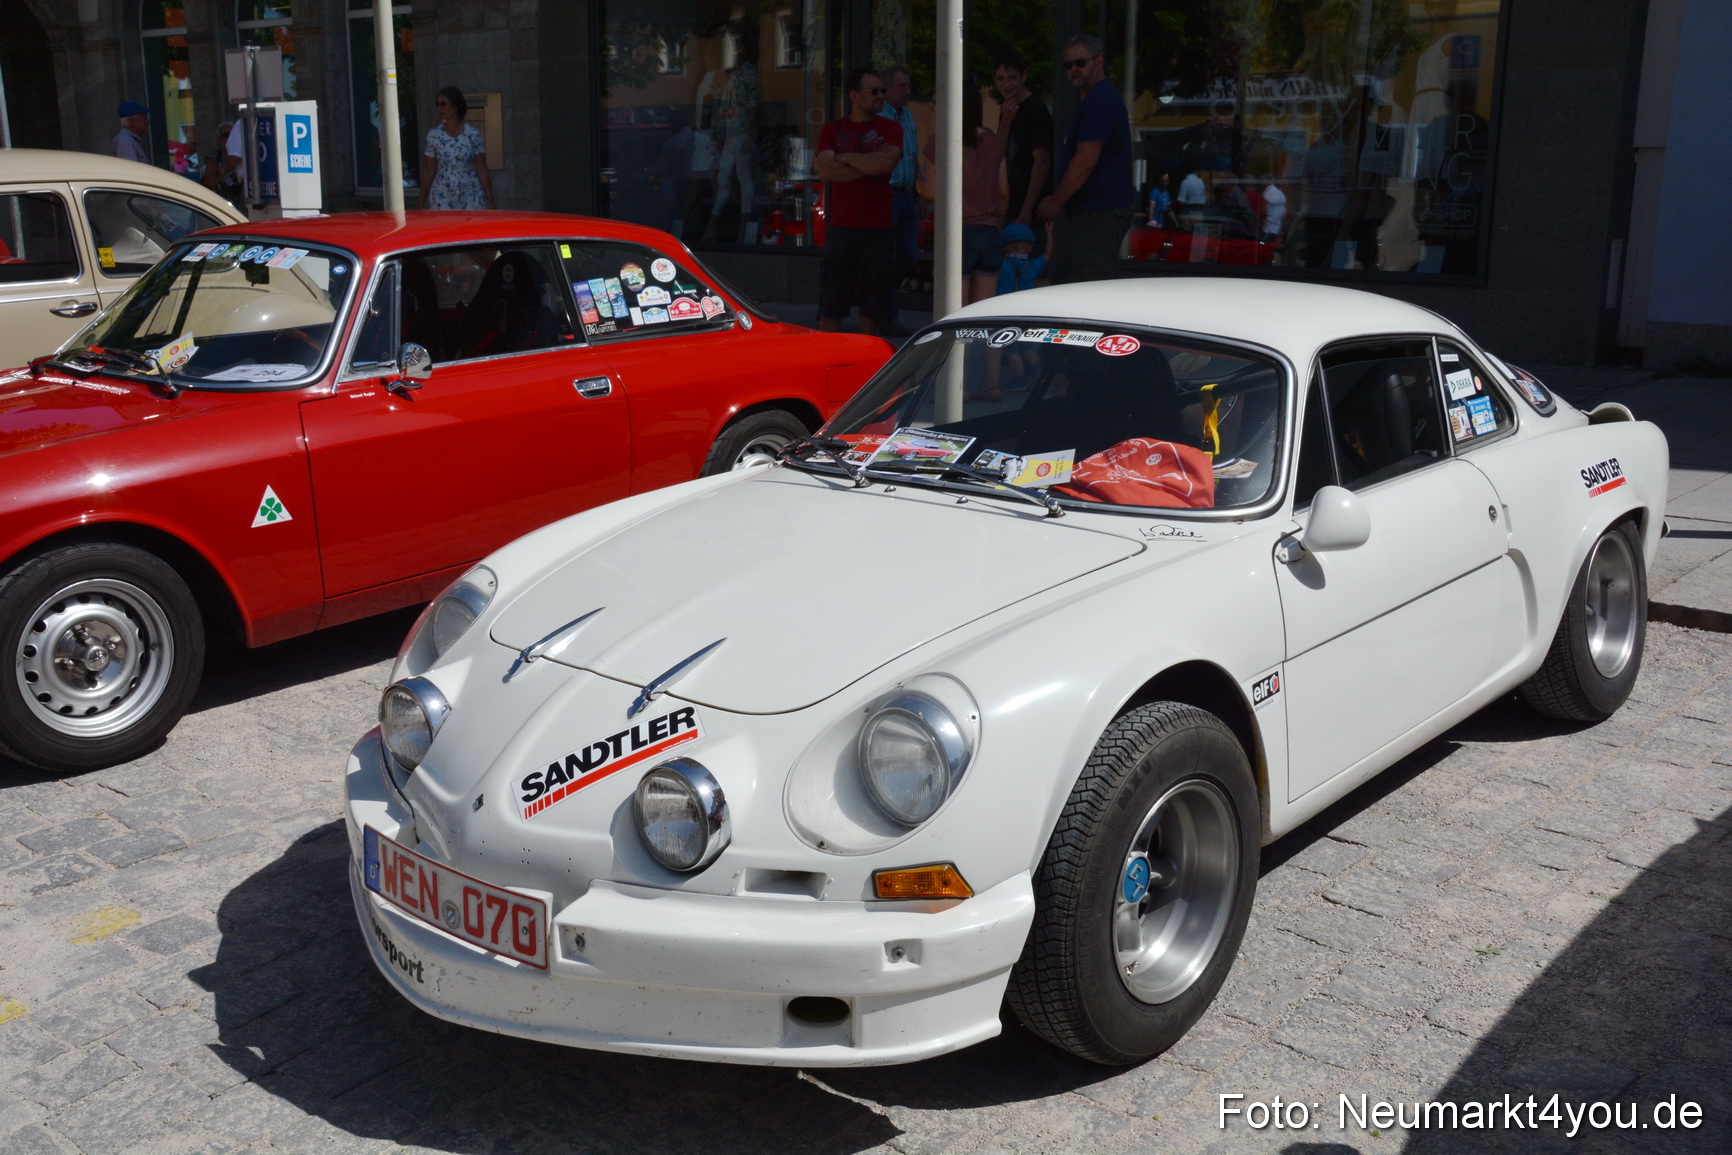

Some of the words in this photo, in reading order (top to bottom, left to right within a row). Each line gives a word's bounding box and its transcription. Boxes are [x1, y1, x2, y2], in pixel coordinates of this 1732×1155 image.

[292, 122, 308, 149] P
[1023, 330, 1046, 339] elf
[1067, 333, 1100, 344] RENAULT
[1456, 377, 1472, 390] DEKRA
[1580, 457, 1624, 489] SANDTLER
[1253, 678, 1270, 703] elf
[520, 706, 697, 803] SANDTLER
[369, 865, 376, 879] D
[380, 844, 440, 922] WEN
[463, 886, 537, 957] 070
